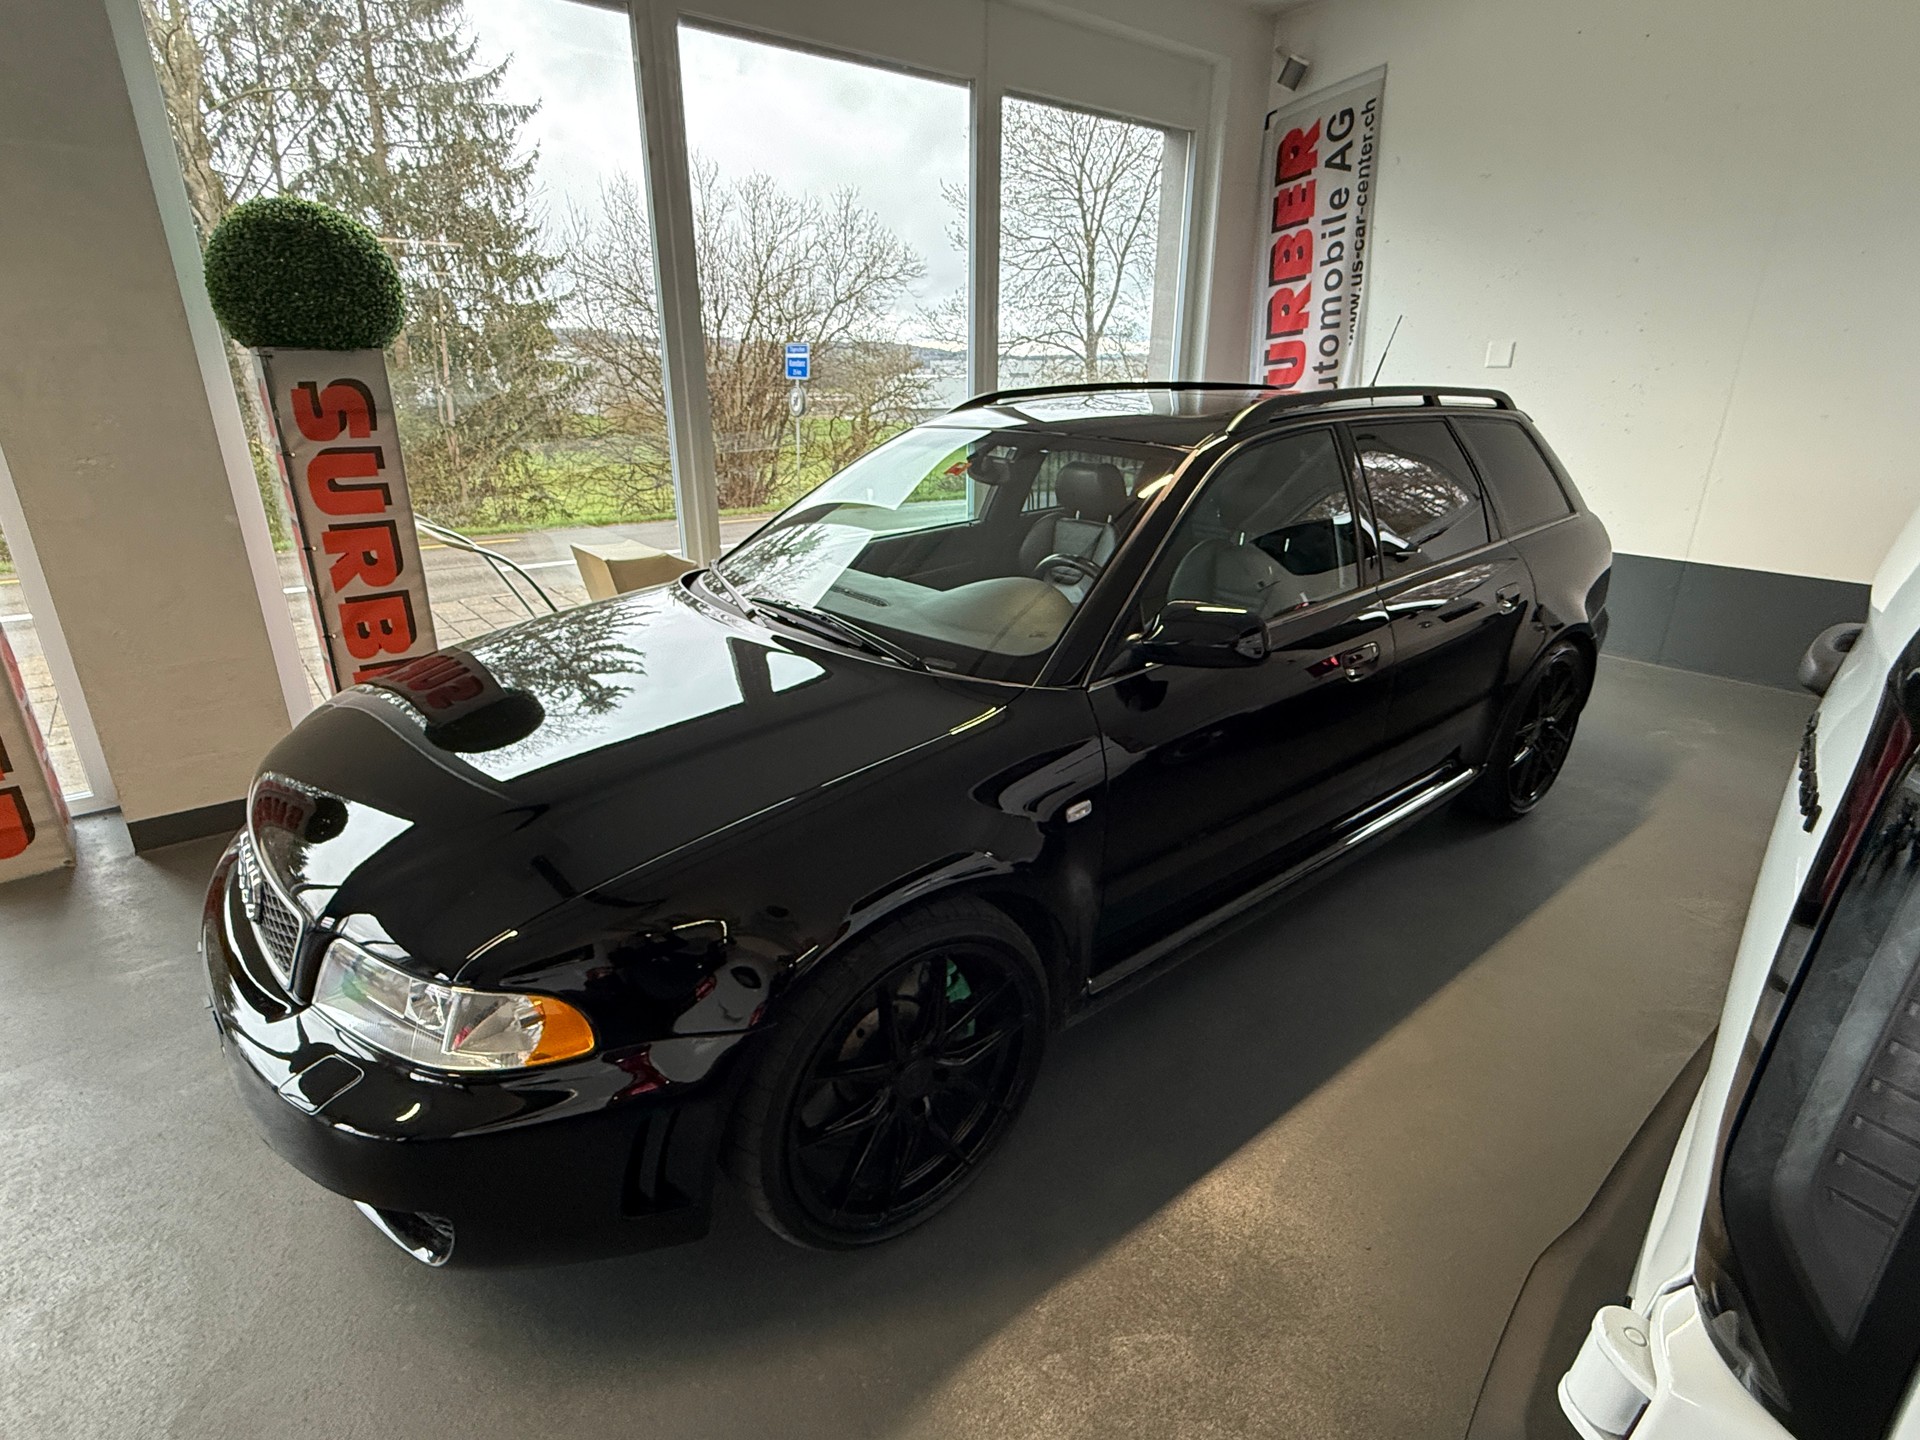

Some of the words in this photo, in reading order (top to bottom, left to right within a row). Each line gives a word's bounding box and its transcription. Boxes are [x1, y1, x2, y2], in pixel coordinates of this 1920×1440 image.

[1260, 117, 1322, 396] URBER
[1324, 106, 1355, 172] AG
[1312, 187, 1350, 389] utomobile
[290, 378, 425, 686] SURB
